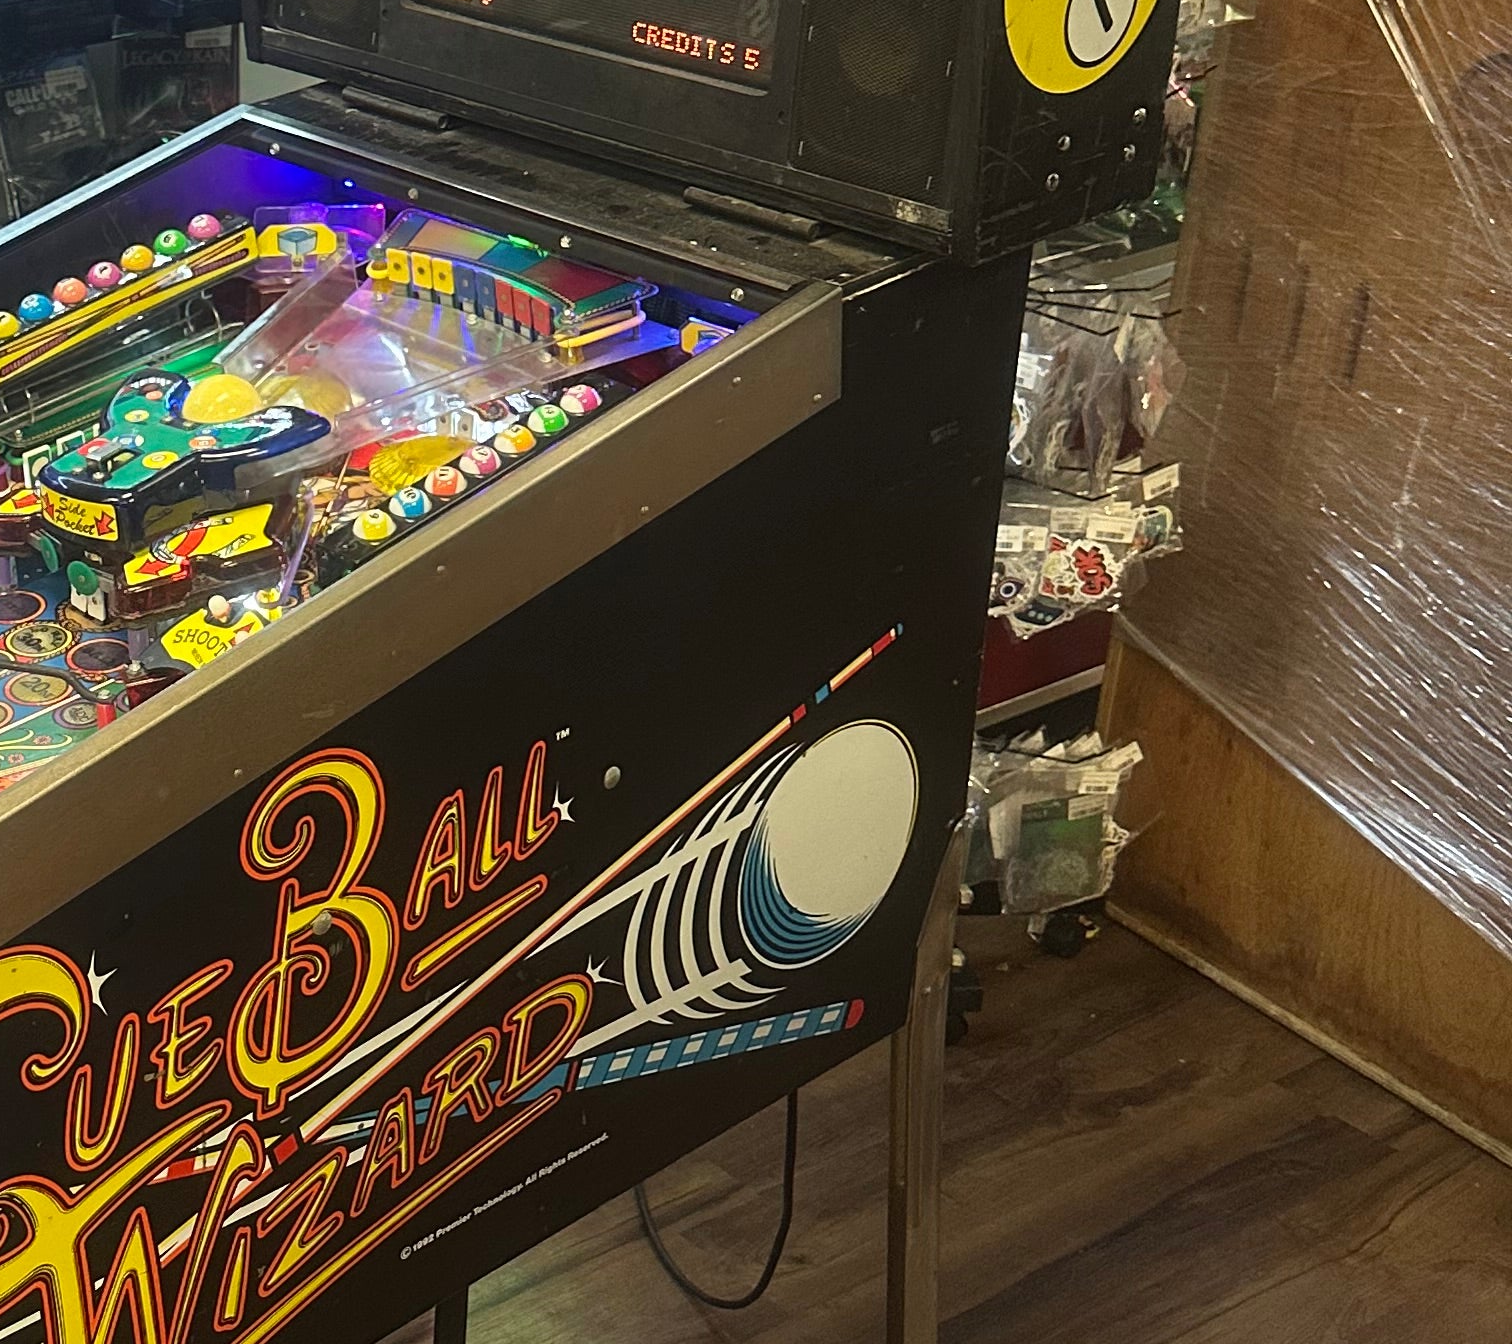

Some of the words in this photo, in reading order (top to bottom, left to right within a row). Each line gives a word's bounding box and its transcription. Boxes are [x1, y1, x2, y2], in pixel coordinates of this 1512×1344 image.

[632, 21, 736, 65] CREDITS
[744, 47, 761, 71] 5
[55, 509, 96, 536] Pocket
[58, 496, 88, 518] Side
[173, 629, 229, 657] SHOOT
[229, 739, 562, 1112] BALL
[412, 1232, 436, 1252] 1992
[435, 1211, 473, 1239] Premier
[472, 1181, 524, 1216] Technology.
[524, 1171, 539, 1187] All
[538, 1155, 567, 1179] Rights
[566, 1131, 609, 1161] Reserved.
